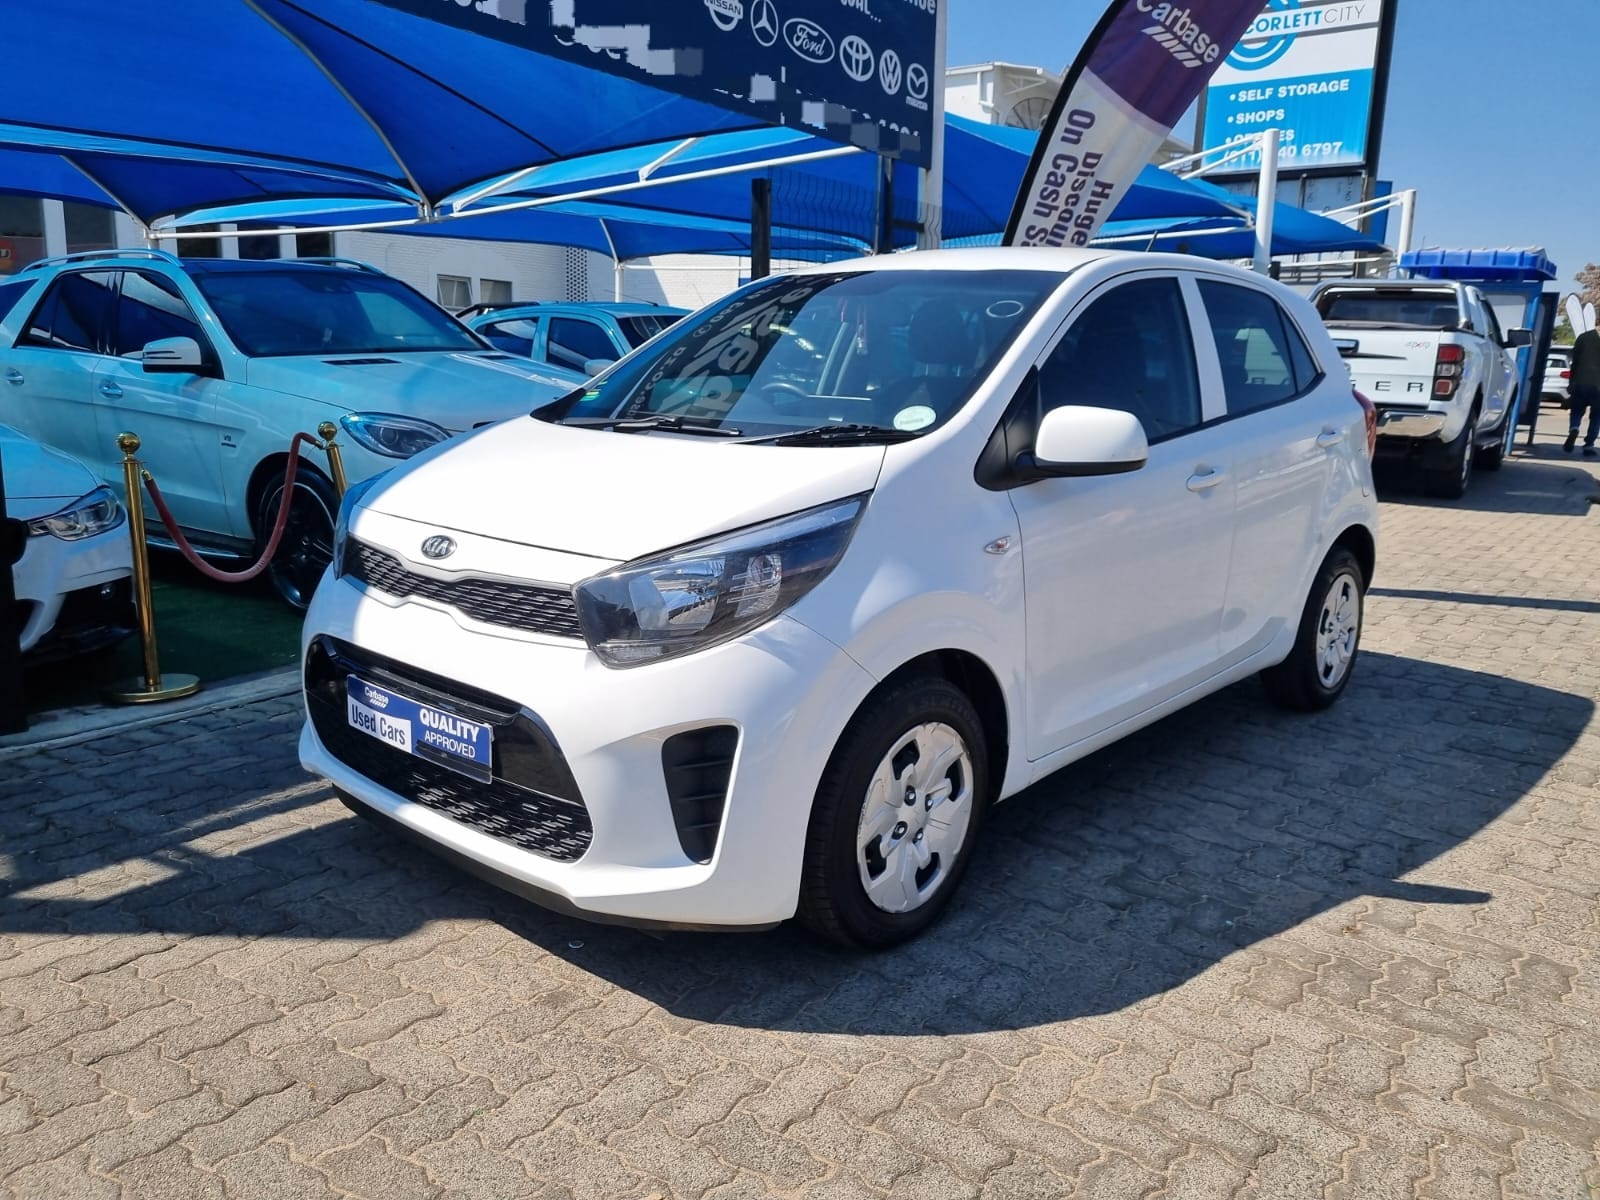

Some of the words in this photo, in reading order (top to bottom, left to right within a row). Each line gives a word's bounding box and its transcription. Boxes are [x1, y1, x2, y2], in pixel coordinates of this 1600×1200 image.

[793, 24, 826, 56] Ford
[1137, 0, 1220, 63] Carbase
[1238, 88, 1274, 102] SELF
[1277, 79, 1350, 98] STORAGE
[1060, 108, 1096, 145] On
[1235, 109, 1285, 124] SHOPS
[1302, 142, 1343, 157] 6797
[1032, 153, 1079, 219] Cash
[1070, 180, 1115, 247] Huge
[364, 686, 389, 704] Carbase
[351, 704, 377, 733] Used
[379, 717, 406, 746] Cars
[420, 708, 480, 743] QUALITY
[424, 730, 476, 759] APPROVED
